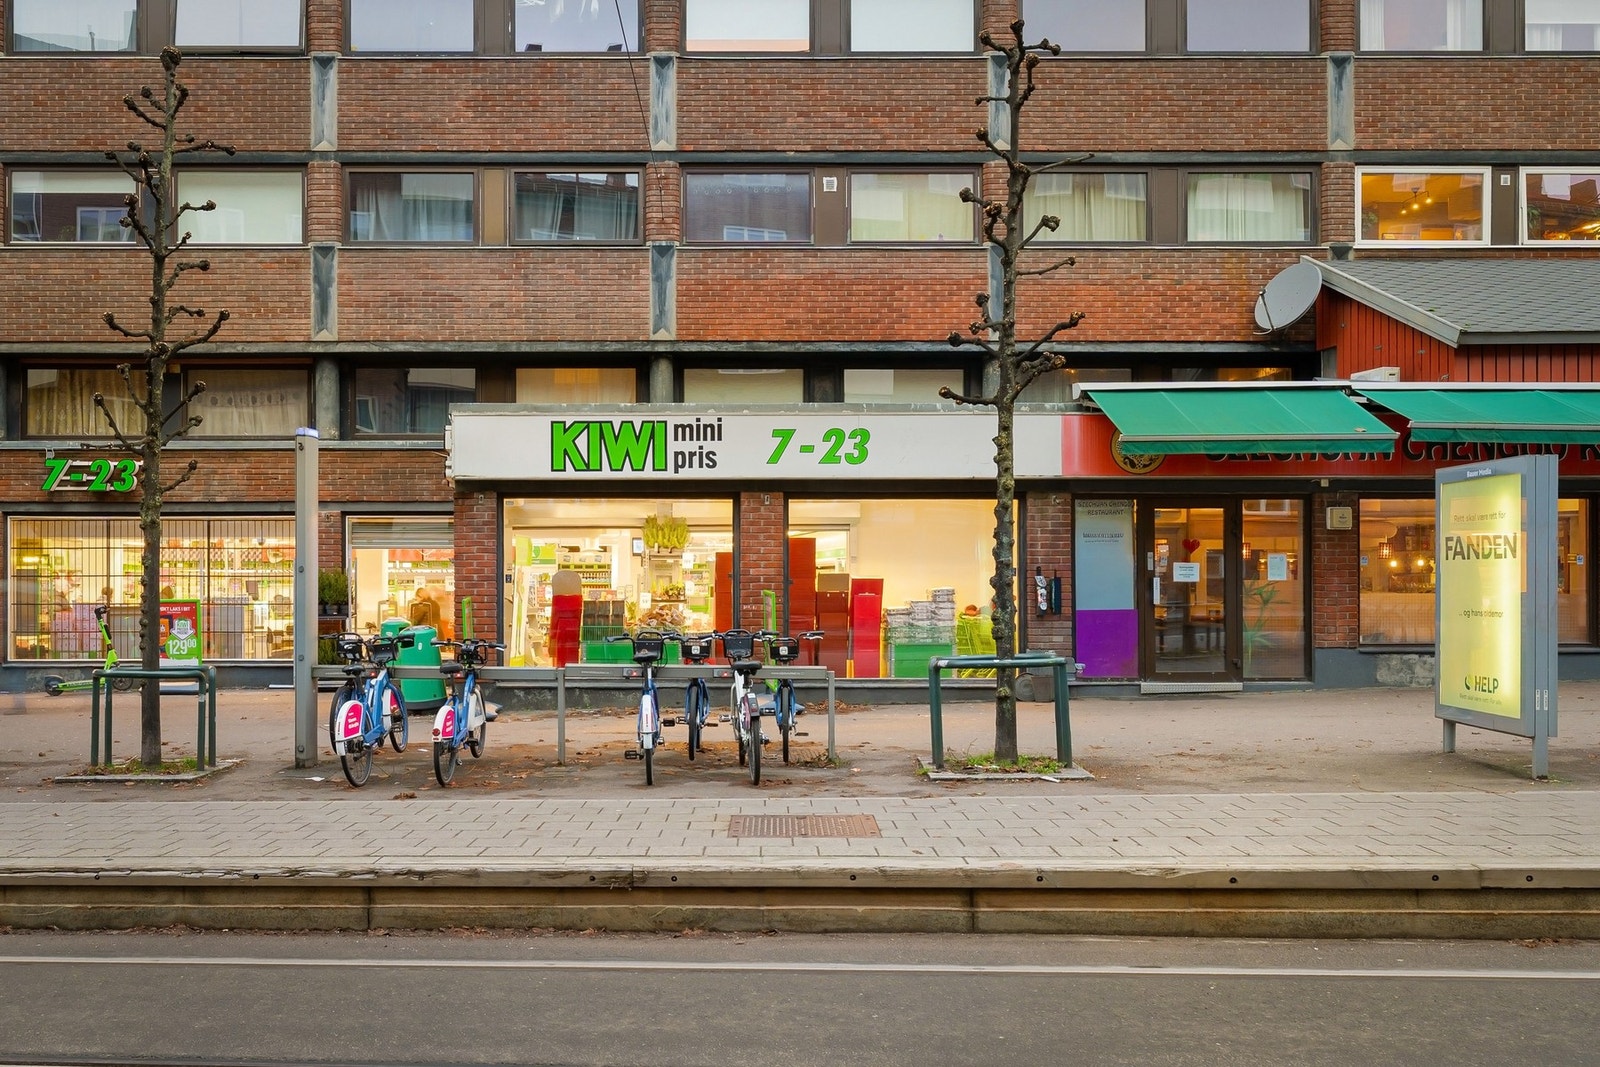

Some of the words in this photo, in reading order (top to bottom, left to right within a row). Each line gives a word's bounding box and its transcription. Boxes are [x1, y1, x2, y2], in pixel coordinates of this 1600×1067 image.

[673, 417, 723, 442] mini
[551, 420, 668, 472] KIWI
[673, 445, 718, 474] pris
[1466, 470, 1478, 478] Bauer
[1479, 468, 1492, 476] Media
[1453, 514, 1465, 523] Rett
[1466, 513, 1477, 522] skal
[1488, 512, 1497, 520] rett
[1498, 510, 1506, 519] for
[1445, 533, 1518, 561] FANDEN
[1463, 610, 1471, 618] og
[1471, 609, 1483, 618] hans
[1474, 675, 1499, 694] HELP
